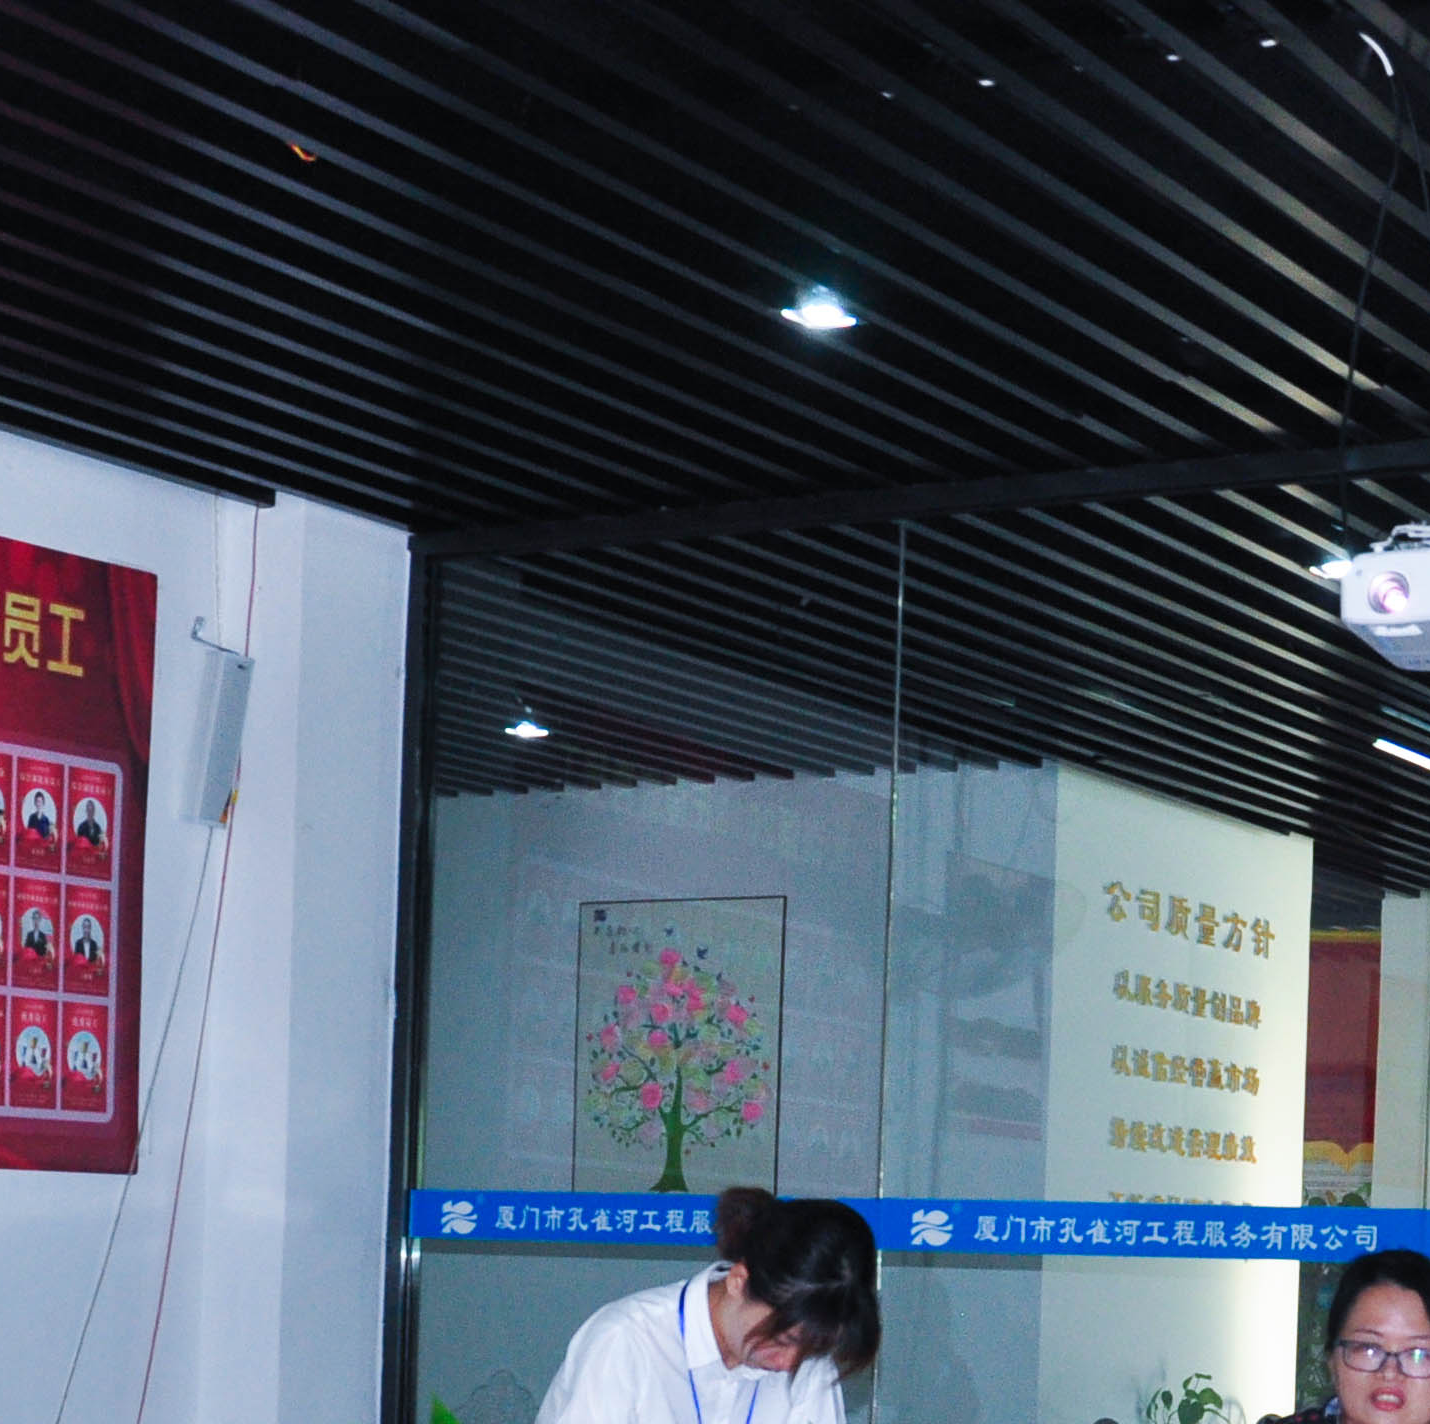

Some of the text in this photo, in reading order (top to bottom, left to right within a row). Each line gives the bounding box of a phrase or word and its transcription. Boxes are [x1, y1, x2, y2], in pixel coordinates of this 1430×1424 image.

[1101, 880, 1276, 959] 公司质量方针
[974, 1214, 1378, 1251] 厦门市孔雀河工程服务有限公司
